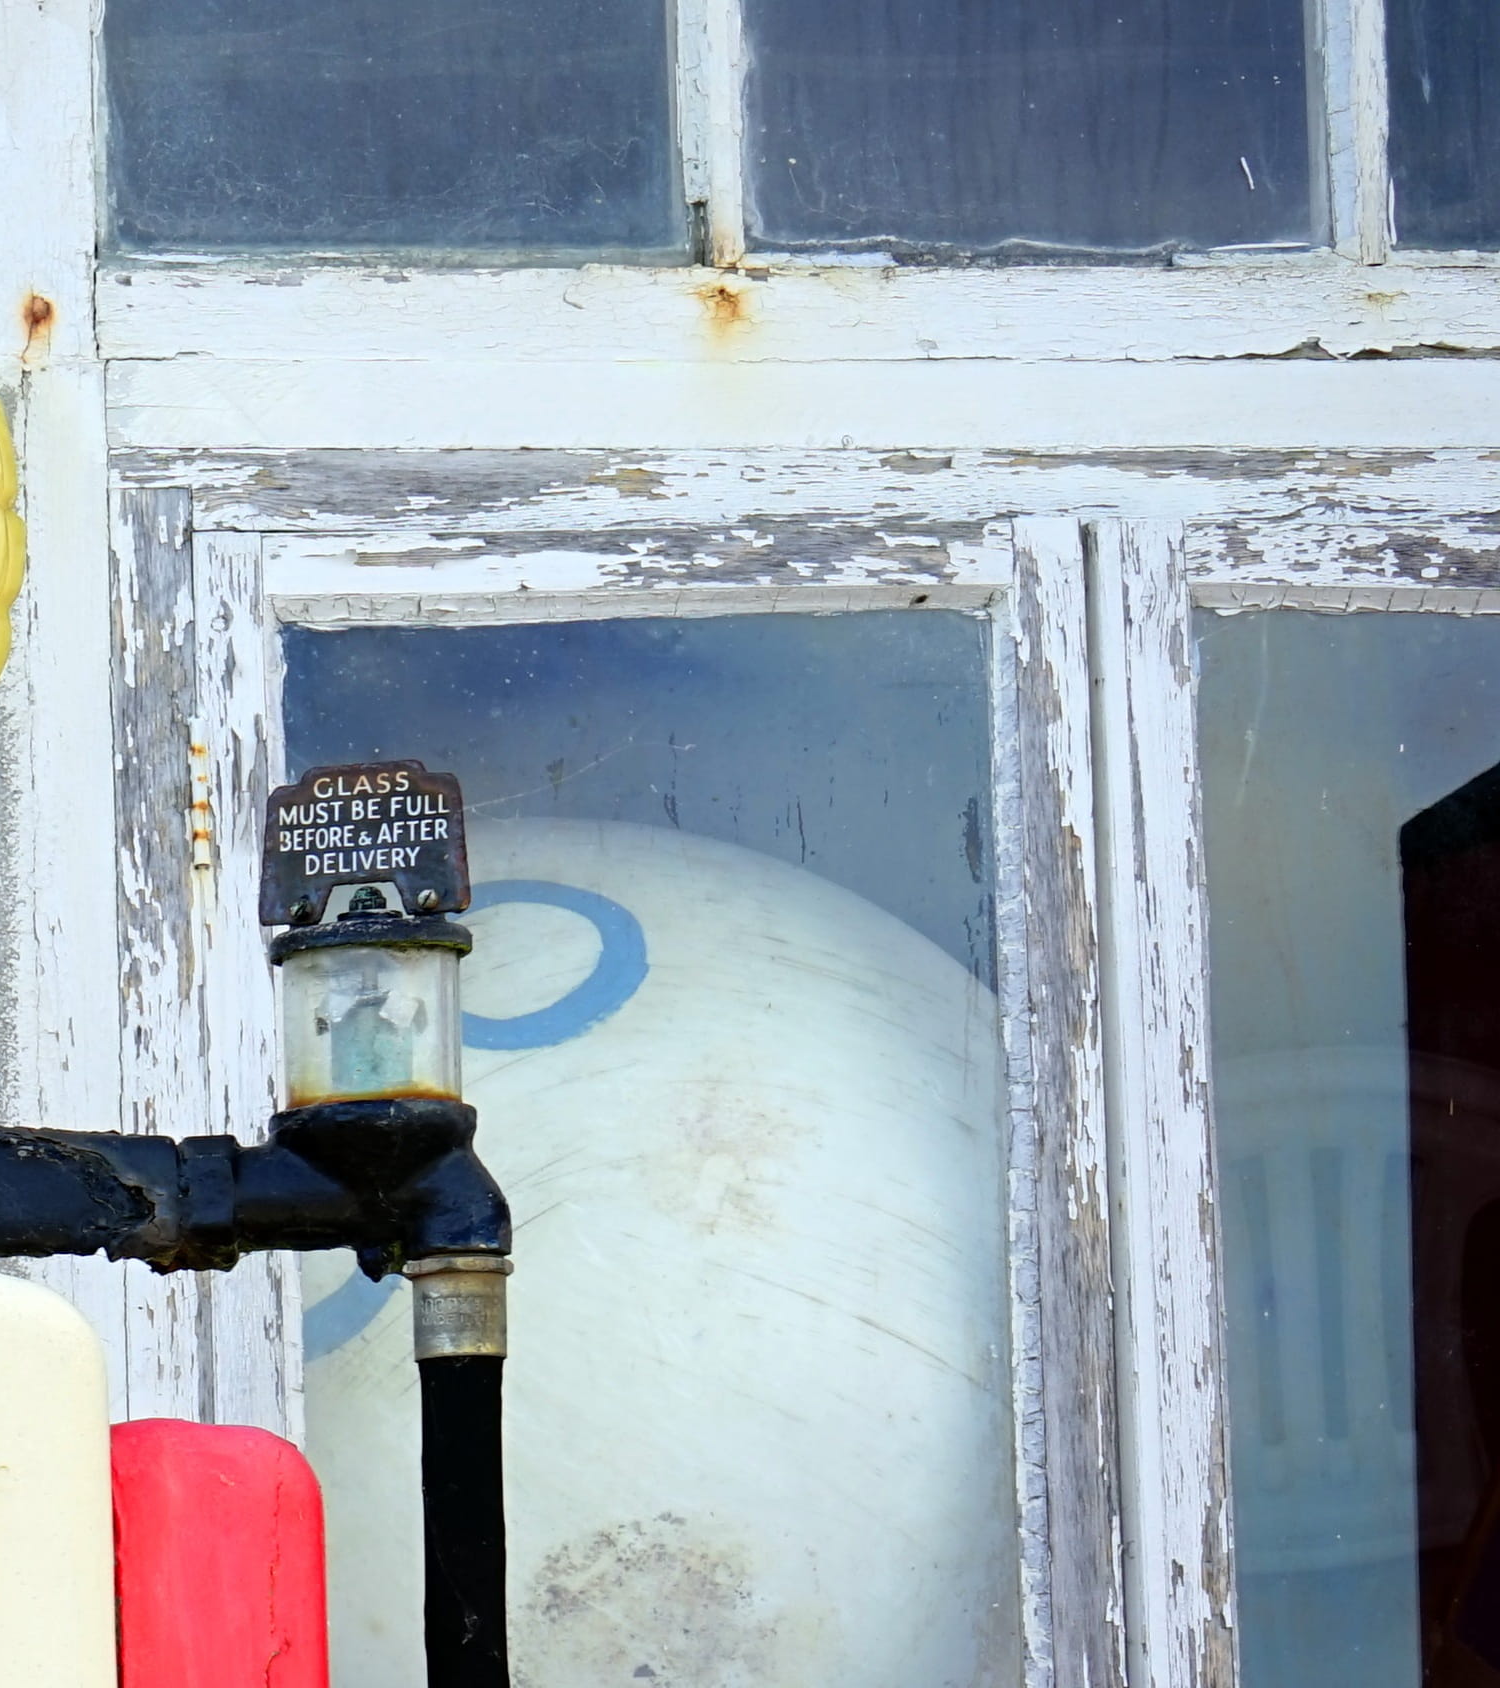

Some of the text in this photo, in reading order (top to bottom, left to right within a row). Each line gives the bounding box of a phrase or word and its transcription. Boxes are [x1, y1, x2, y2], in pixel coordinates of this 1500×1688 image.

[313, 770, 410, 799] GLASS
[278, 794, 450, 827] MUST BE FULL
[279, 818, 449, 852] BEFORE & AFTER
[304, 846, 421, 876] DELIVERY
